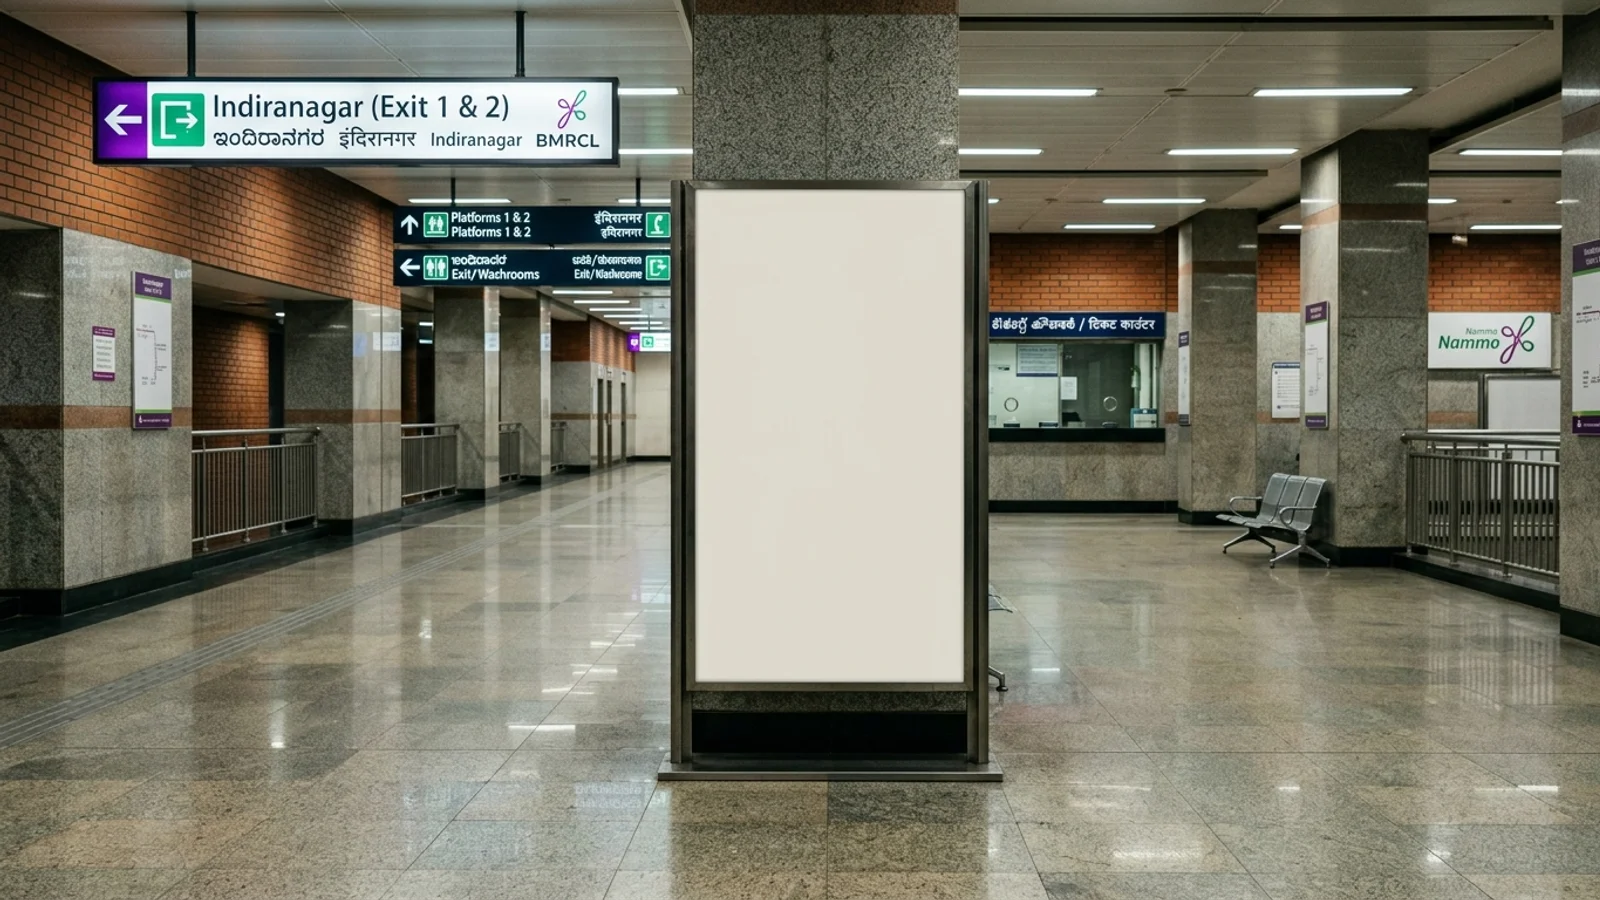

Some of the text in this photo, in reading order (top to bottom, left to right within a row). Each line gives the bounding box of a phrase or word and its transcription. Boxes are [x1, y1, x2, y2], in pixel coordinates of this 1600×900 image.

[214, 93, 509, 124] Indiranagar (Exit 1 & 2)
[338, 127, 417, 149] इंदिरानगर
[431, 131, 523, 151] Indiranagar
[536, 133, 600, 148] BMRCL
[451, 211, 531, 223] Platforms 1 & 2
[451, 226, 532, 238] Platforms 1 & 2
[1438, 335, 1500, 350] Nammo
